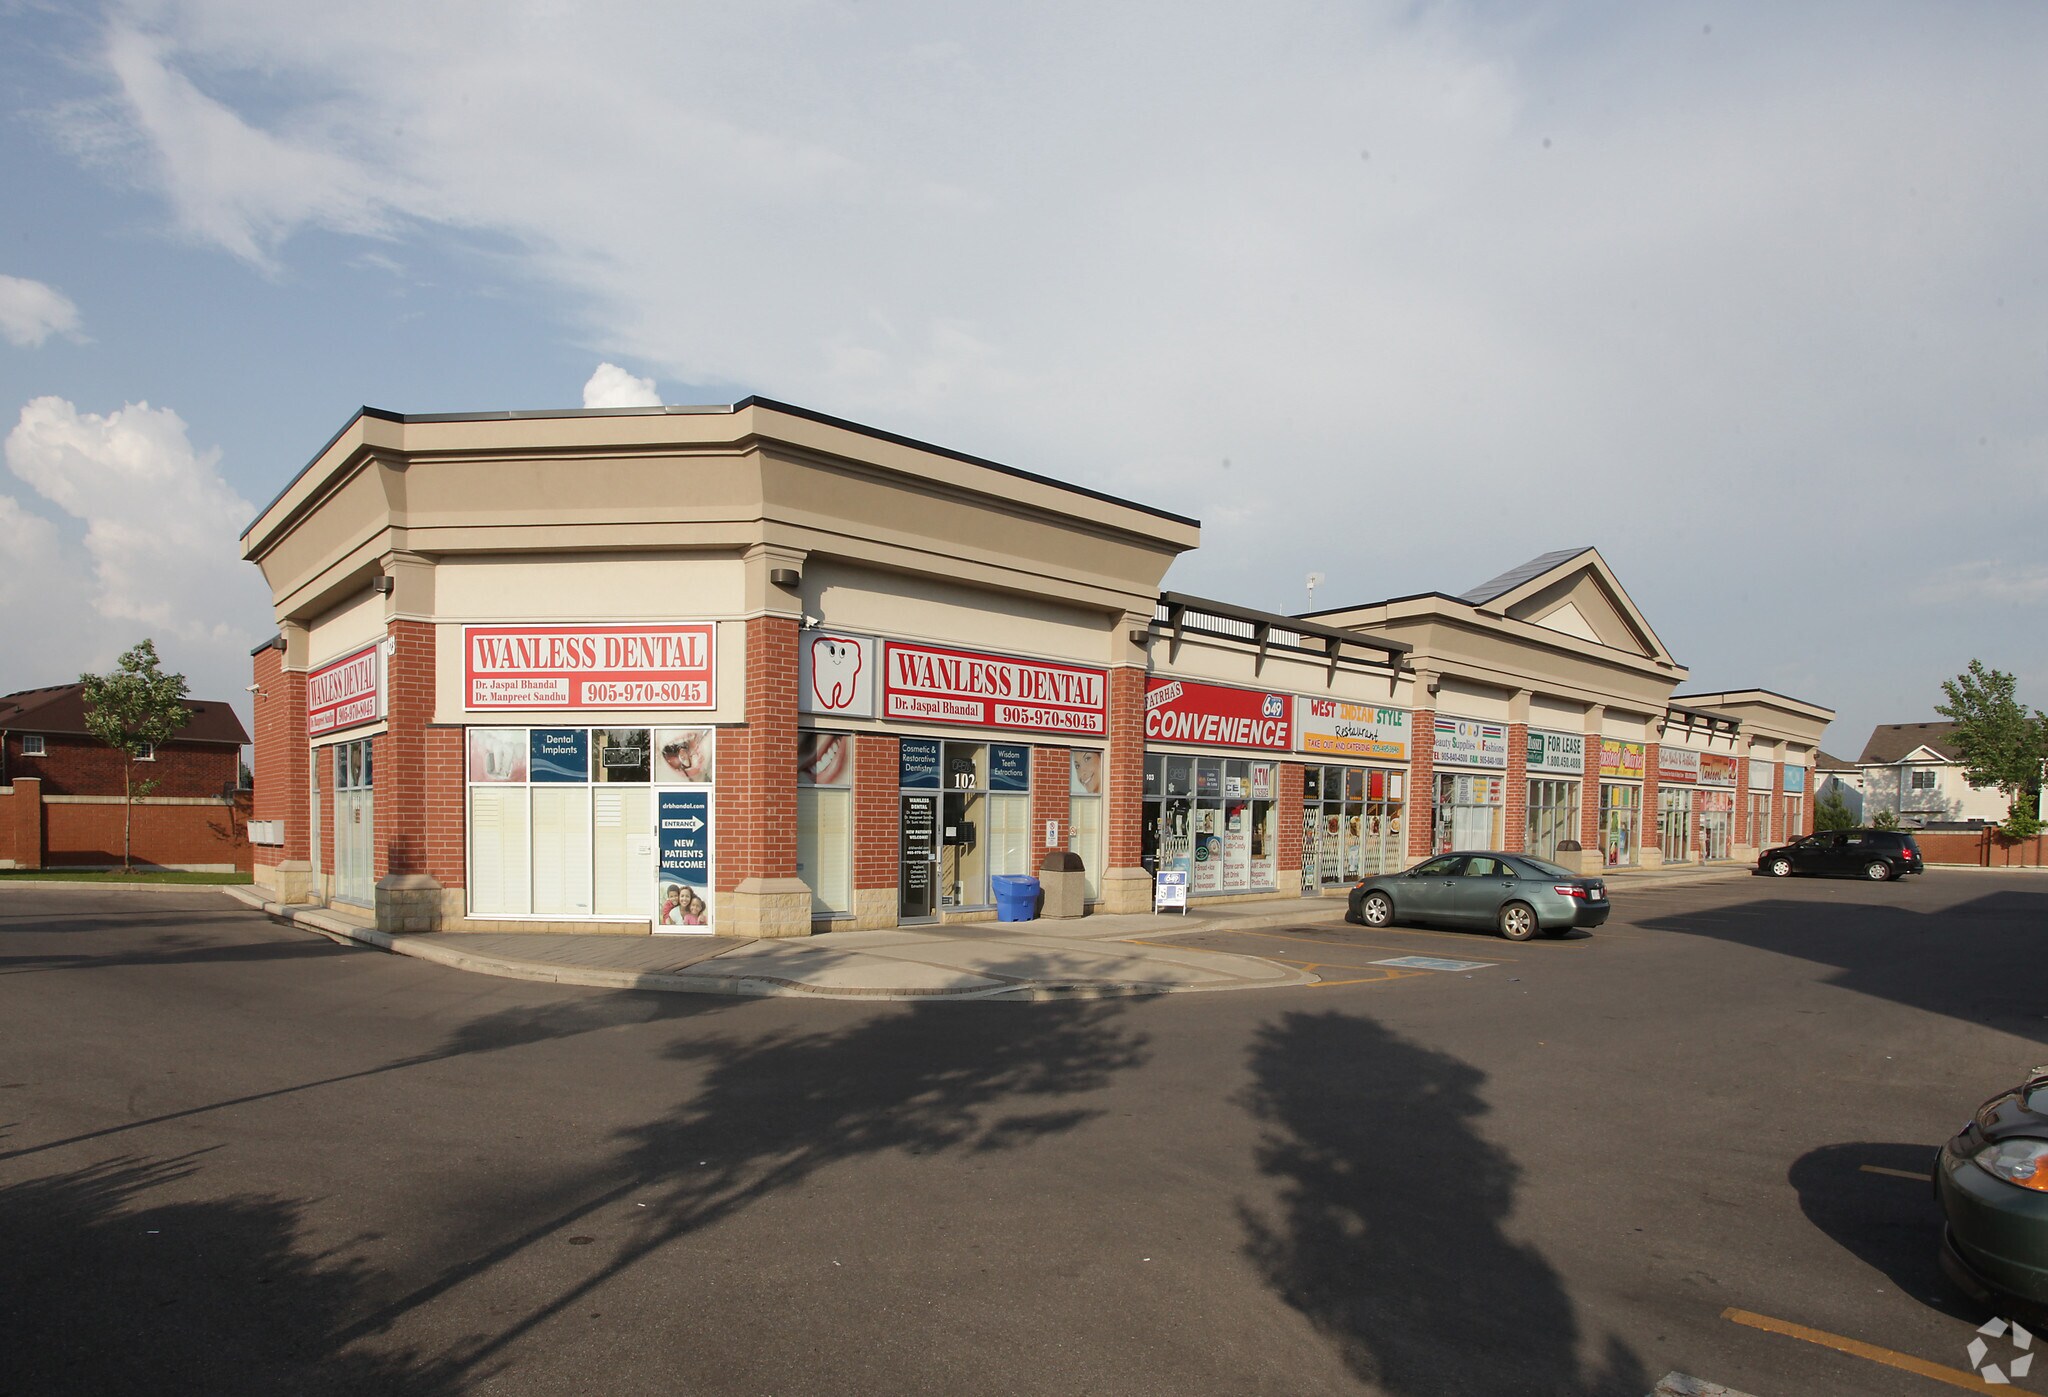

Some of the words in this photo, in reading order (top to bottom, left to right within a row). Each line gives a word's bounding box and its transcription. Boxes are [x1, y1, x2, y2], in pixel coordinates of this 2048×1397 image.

[476, 638, 596, 668] WANLESS
[604, 636, 704, 668] DENTAL
[311, 670, 342, 706] WANLESS
[344, 658, 374, 696] DENTAL
[475, 680, 488, 689] Dr.
[490, 680, 518, 691] Jaspal
[521, 680, 557, 689] Bhandal
[896, 652, 1011, 696] WANLESS
[1018, 668, 1098, 706] DENTAL
[475, 692, 488, 701] Dr.
[490, 692, 531, 703] Manpreet
[533, 692, 566, 701] Sandhu
[588, 683, 701, 701] 905-970-8045
[895, 697, 908, 710] Dr.
[911, 699, 940, 716] Jaspal
[942, 702, 978, 716] Bhandal
[1311, 699, 1336, 718] WEST
[1340, 703, 1375, 723] INDIAN
[1376, 710, 1402, 726] STYLE
[1002, 707, 1096, 729] 905-970-8045
[1146, 709, 1288, 746] CONVENIENCE
[1335, 722, 1378, 742] Restaurant
[1459, 723, 1466, 736] C
[1468, 724, 1472, 736] &
[1474, 725, 1479, 737] J
[546, 735, 573, 744] Dental
[1308, 739, 1320, 749] TAKE
[1323, 741, 1334, 749] OUT
[1335, 742, 1345, 750] AND
[1346, 743, 1370, 752] CATERING
[1452, 737, 1475, 751] Supplies
[1482, 740, 1504, 753] Fashions
[1548, 736, 1560, 752] FOR
[1562, 738, 1581, 754] LEASE
[542, 746, 578, 755] Implants
[902, 744, 930, 753] Cosmetic
[998, 750, 1020, 758] Wisdom
[902, 754, 936, 763] Restorative
[1002, 759, 1016, 767] Teeth
[1470, 755, 1478, 763] FAX
[906, 764, 932, 774] Dentistry
[994, 768, 1023, 776] Extractions
[954, 773, 975, 788] 102
[1254, 768, 1268, 786] ATM
[664, 850, 703, 858] PATIENTS
